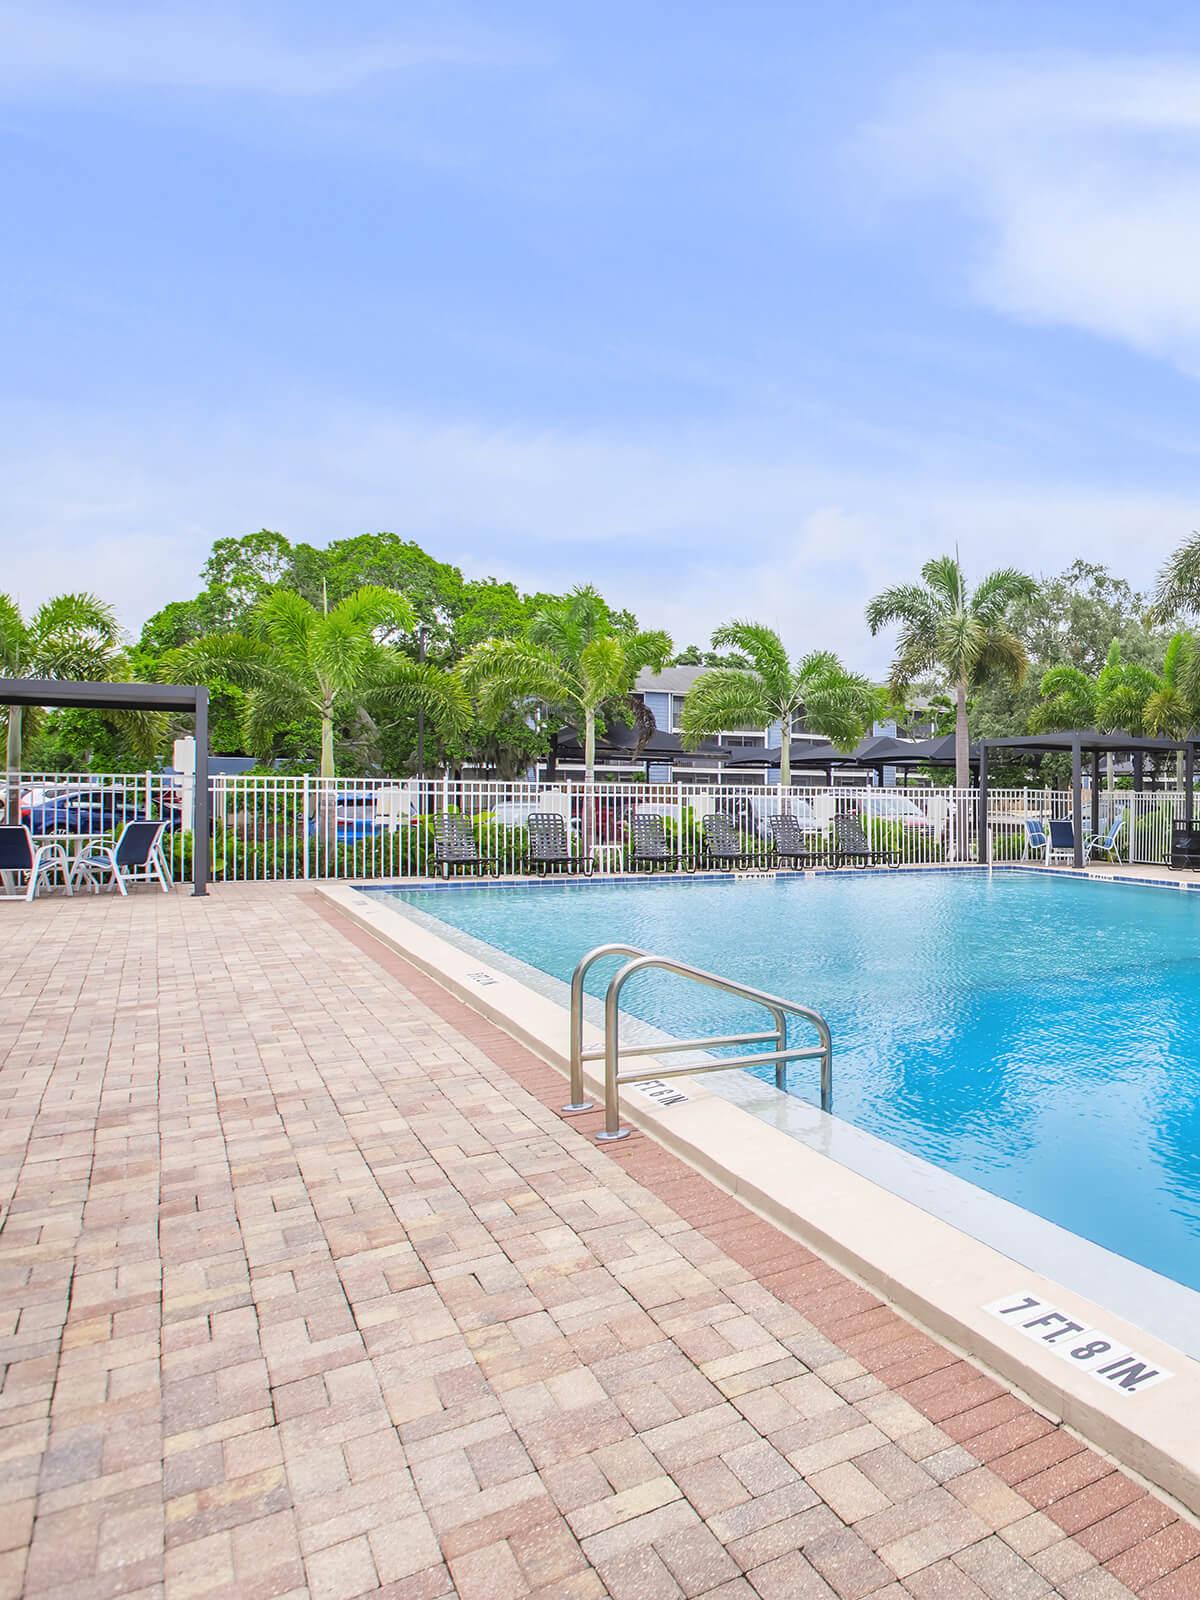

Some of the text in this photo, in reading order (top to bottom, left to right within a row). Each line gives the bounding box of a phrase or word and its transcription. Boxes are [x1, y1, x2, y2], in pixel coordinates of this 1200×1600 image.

[999, 1296, 1160, 1392] 7 FT. 8 IN.
